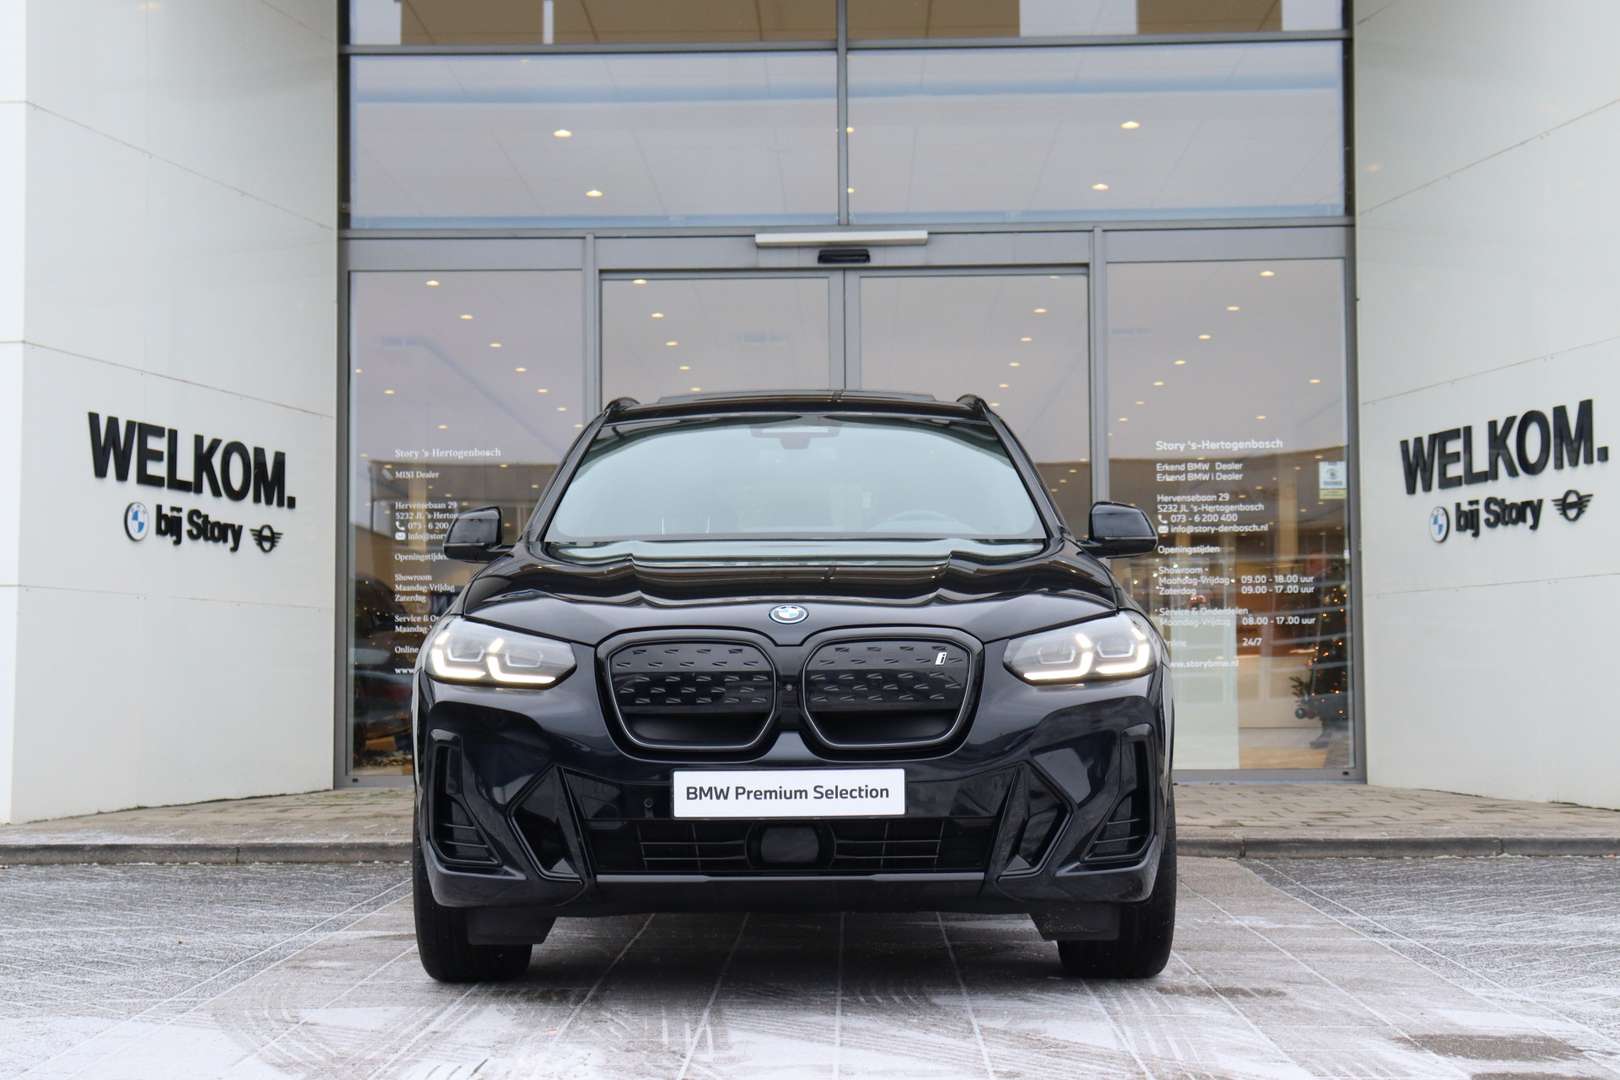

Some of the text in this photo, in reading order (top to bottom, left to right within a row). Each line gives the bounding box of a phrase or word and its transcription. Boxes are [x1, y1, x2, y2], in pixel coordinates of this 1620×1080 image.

[1156, 440, 1184, 452] Story
[1400, 399, 1609, 495] WELKOM.
[395, 448, 418, 459] Story
[88, 411, 296, 508] WELKOM.
[1187, 462, 1209, 471] BMW
[416, 470, 440, 478] Dealer
[1187, 473, 1210, 481] BMW
[1218, 493, 1230, 501] 29
[1157, 504, 1178, 512] 5232
[1170, 514, 1186, 522] 073
[1202, 513, 1219, 522] 200
[1220, 513, 1238, 521] 400
[1455, 497, 1543, 537] bij Story
[156, 504, 243, 552] bij Story
[1157, 545, 1220, 555] Openingstijden
[1241, 575, 1267, 584] 09.00
[1274, 574, 1299, 583] 18.00
[1241, 585, 1268, 594] 09.00
[394, 614, 422, 622] Service
[1242, 616, 1268, 625] 08.00
[686, 785, 890, 800] BMW Premium Selection
